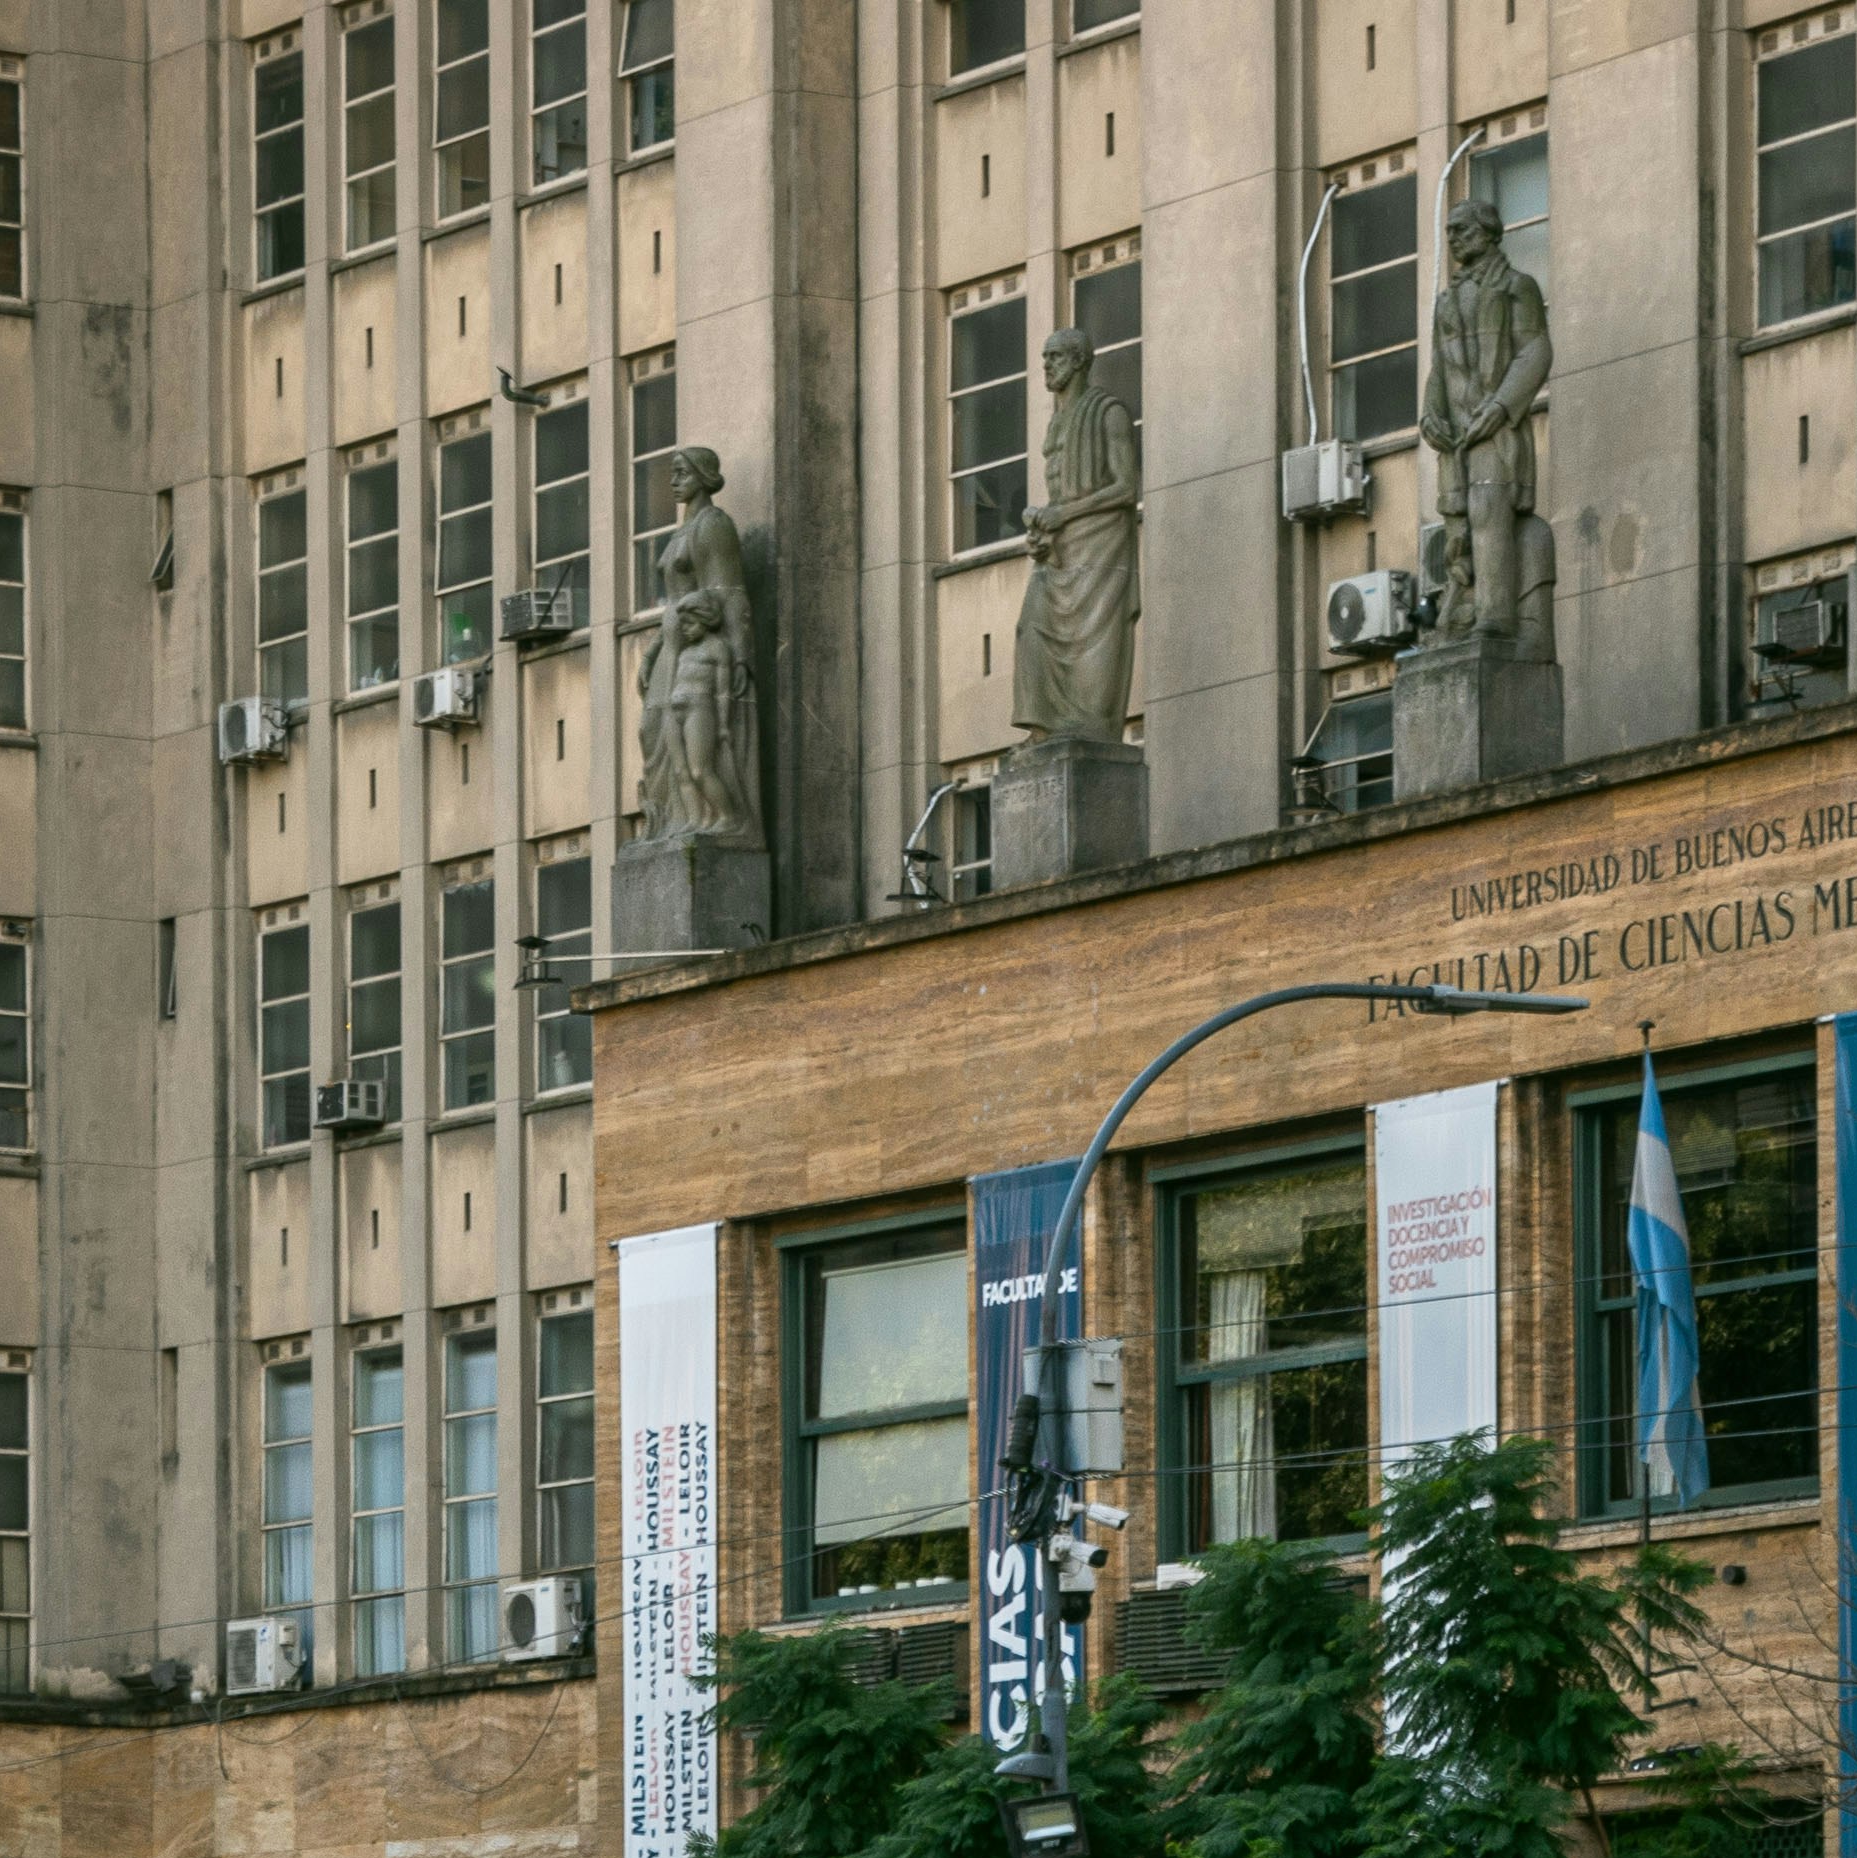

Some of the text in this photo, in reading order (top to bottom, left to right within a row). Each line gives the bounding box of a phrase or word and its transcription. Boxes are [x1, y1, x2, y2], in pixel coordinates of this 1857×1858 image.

[1451, 855, 1620, 921] UNIVERSIDAD
[1631, 843, 1663, 882] DE
[1674, 817, 1787, 876] BUENOS
[1558, 930, 1601, 985] DE
[1619, 891, 1796, 973] CIENCIAS
[1387, 1185, 1492, 1225] INVESTIGACIÓN
[1388, 1215, 1470, 1248] DOCENCIA Y
[982, 1270, 1049, 1309] FACULTA
[1388, 1237, 1486, 1271] COMPROMISO
[1389, 1270, 1437, 1295] SOCIAL
[646, 1428, 660, 1552] HOUSSAY
[661, 1426, 676, 1547] MILSTEIN
[696, 1421, 708, 1544] HOUSSAY
[663, 1583, 675, 1674] LELOIR
[678, 1424, 692, 1831] MILSTEIN HOUSSAY LELOIR
[664, 1711, 676, 1834] HOUSSAY
